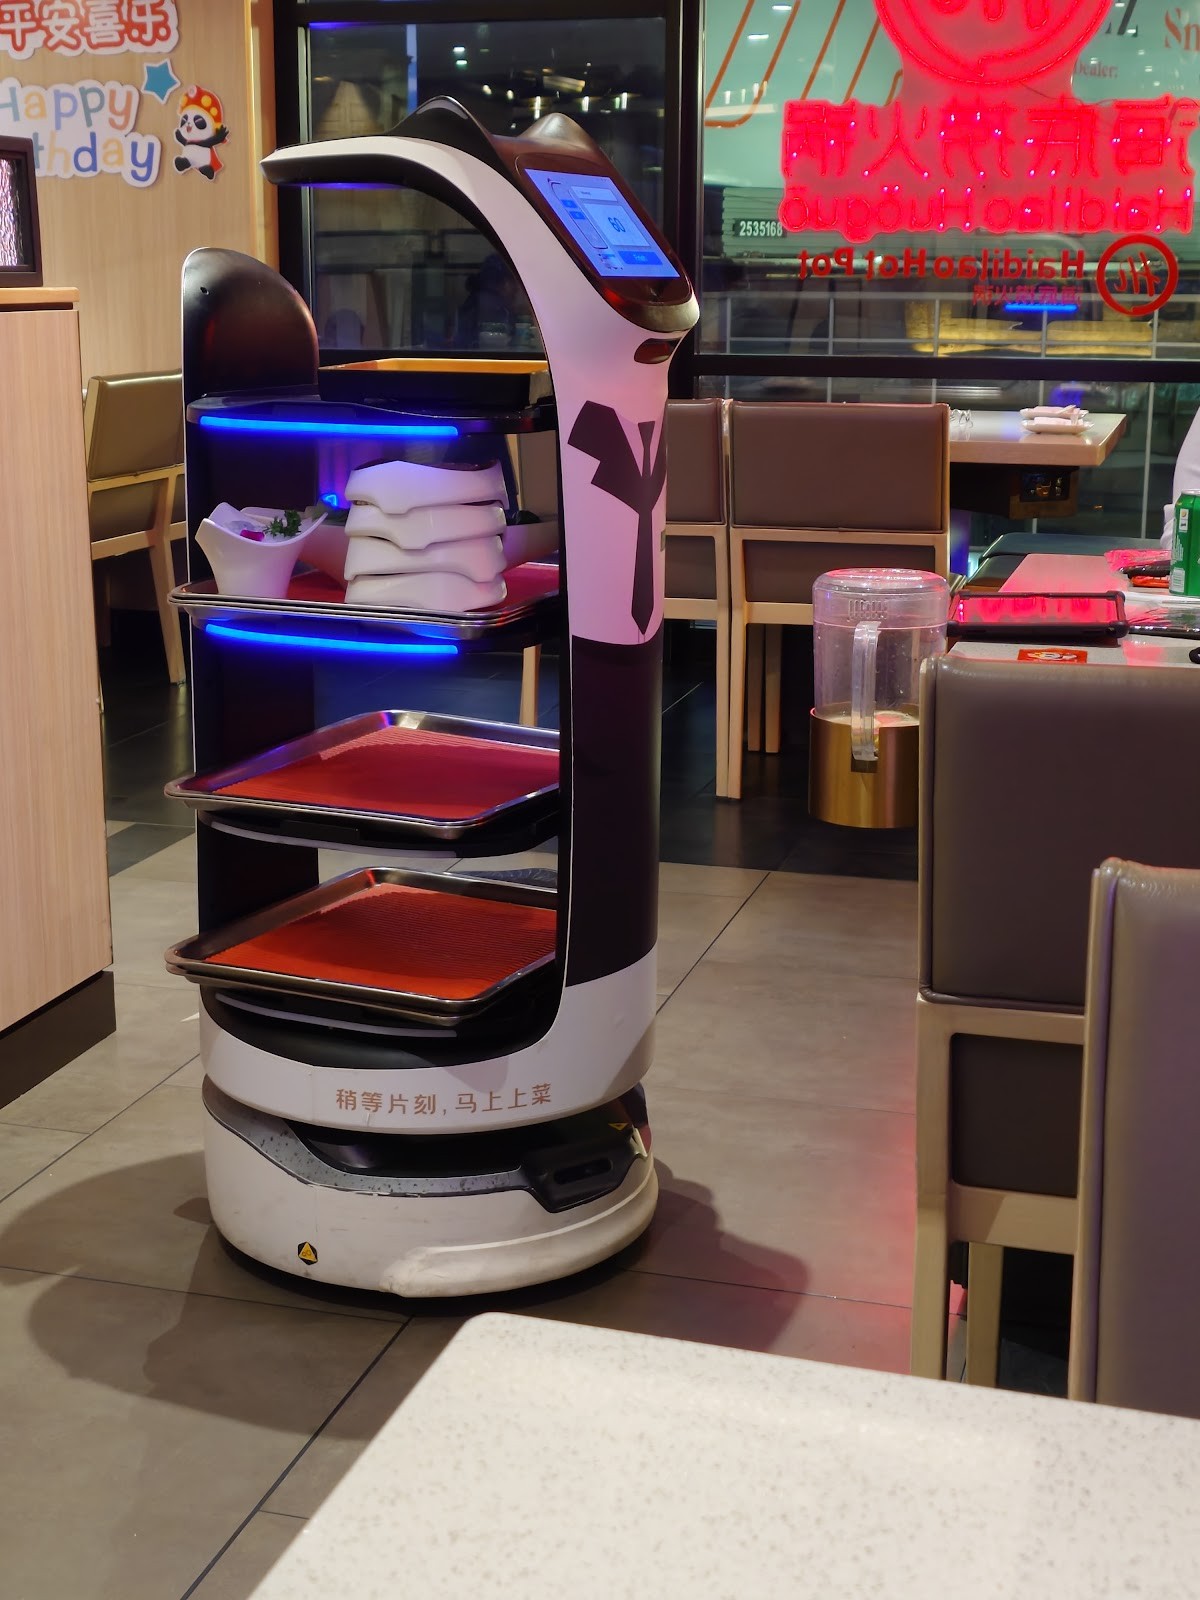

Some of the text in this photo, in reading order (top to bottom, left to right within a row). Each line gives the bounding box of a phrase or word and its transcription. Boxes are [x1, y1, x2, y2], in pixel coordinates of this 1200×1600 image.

[0, 0, 170, 50] 平安喜乐
[32, 130, 155, 182] thday
[608, 217, 626, 232] 60
[739, 220, 783, 237] 2535168
